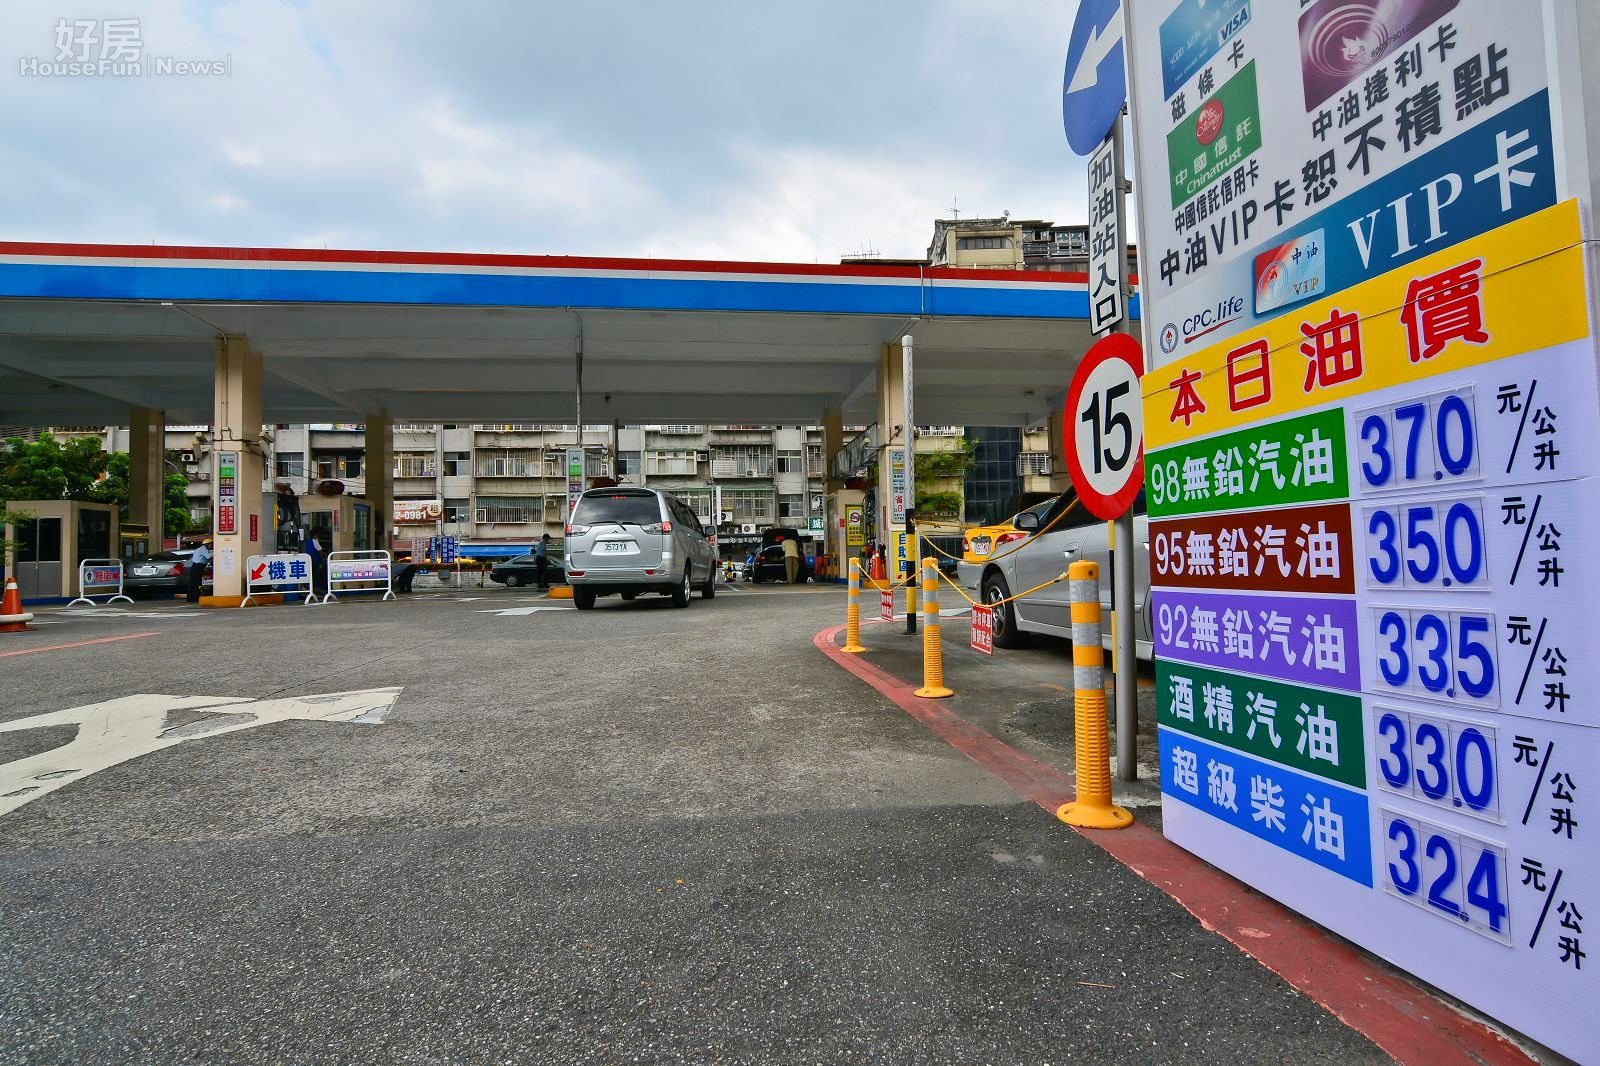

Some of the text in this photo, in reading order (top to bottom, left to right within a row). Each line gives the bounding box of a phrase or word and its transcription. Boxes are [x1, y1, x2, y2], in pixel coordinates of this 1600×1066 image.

[1221, 7, 1248, 40] VISA
[1171, 39, 1245, 123] 磁條卡
[1312, 23, 1457, 142] 中油捷利卡
[1175, 116, 1252, 185] 中國信託
[1187, 146, 1242, 194] Chinatrust
[1092, 150, 1117, 327] 加油站入口
[1175, 159, 1259, 235] 中國信託信用卡
[1347, 128, 1539, 269] VIP卡
[1292, 241, 1319, 266] 中油
[1293, 277, 1319, 296] VIP
[1169, 258, 1490, 427] 本日油價
[1081, 380, 1132, 474] 15
[1151, 427, 1335, 505] 98無鉛汽油
[1360, 395, 1473, 486] 37.0
[268, 560, 308, 580] 機車
[1154, 520, 1341, 578] 95無鉛汽油
[1368, 503, 1481, 587] 35.0
[1158, 604, 1347, 675] 92無鉛汽油
[1379, 611, 1494, 698] 33.5
[1169, 674, 1340, 767] 酒精汽油
[1378, 713, 1493, 809] 33.0
[1171, 745, 1346, 861] 超級柴油
[1387, 819, 1506, 932] 32.4
